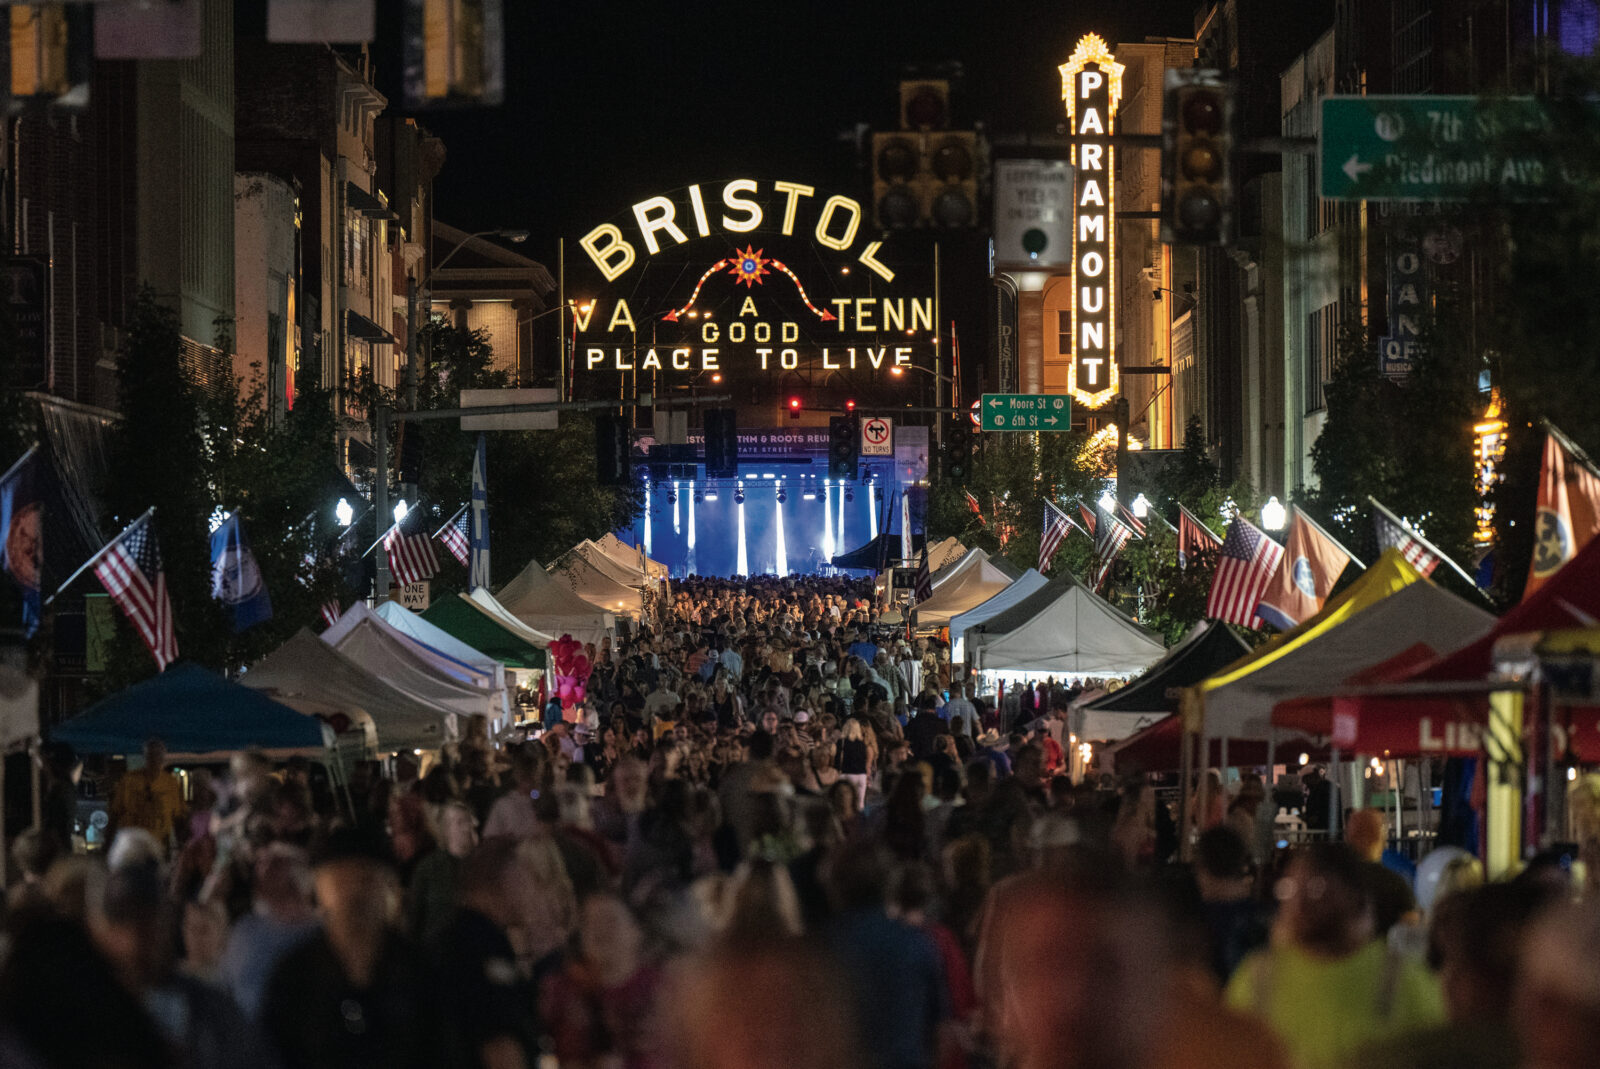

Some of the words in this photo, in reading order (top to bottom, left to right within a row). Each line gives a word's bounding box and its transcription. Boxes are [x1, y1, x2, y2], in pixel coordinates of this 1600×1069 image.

[1426, 110, 1462, 142] 7th
[578, 178, 896, 283] BRISTOL
[1079, 71, 1105, 386] PARAMOUNT
[1396, 236, 1422, 335] OAN
[568, 299, 636, 332] VA
[739, 296, 758, 317] A
[831, 298, 932, 332] TENN
[702, 323, 799, 343] GOOD
[587, 348, 720, 370] PLACE
[756, 348, 798, 370] TO
[822, 347, 913, 369] LIVE
[1386, 341, 1427, 360] OF
[1386, 362, 1414, 372] MUSICA
[1009, 398, 1034, 409] Moore
[1037, 398, 1046, 409] St
[1012, 415, 1025, 426] 6th
[1029, 415, 1038, 426] St
[686, 435, 705, 444] ISTO
[736, 435, 758, 444] THM
[760, 435, 767, 444] &
[770, 435, 804, 444] ROOTS
[807, 435, 830, 444] REU
[471, 449, 490, 589] ATM
[404, 584, 424, 593] ONE
[404, 594, 425, 604] WAY
[1418, 716, 1488, 752] LIB
